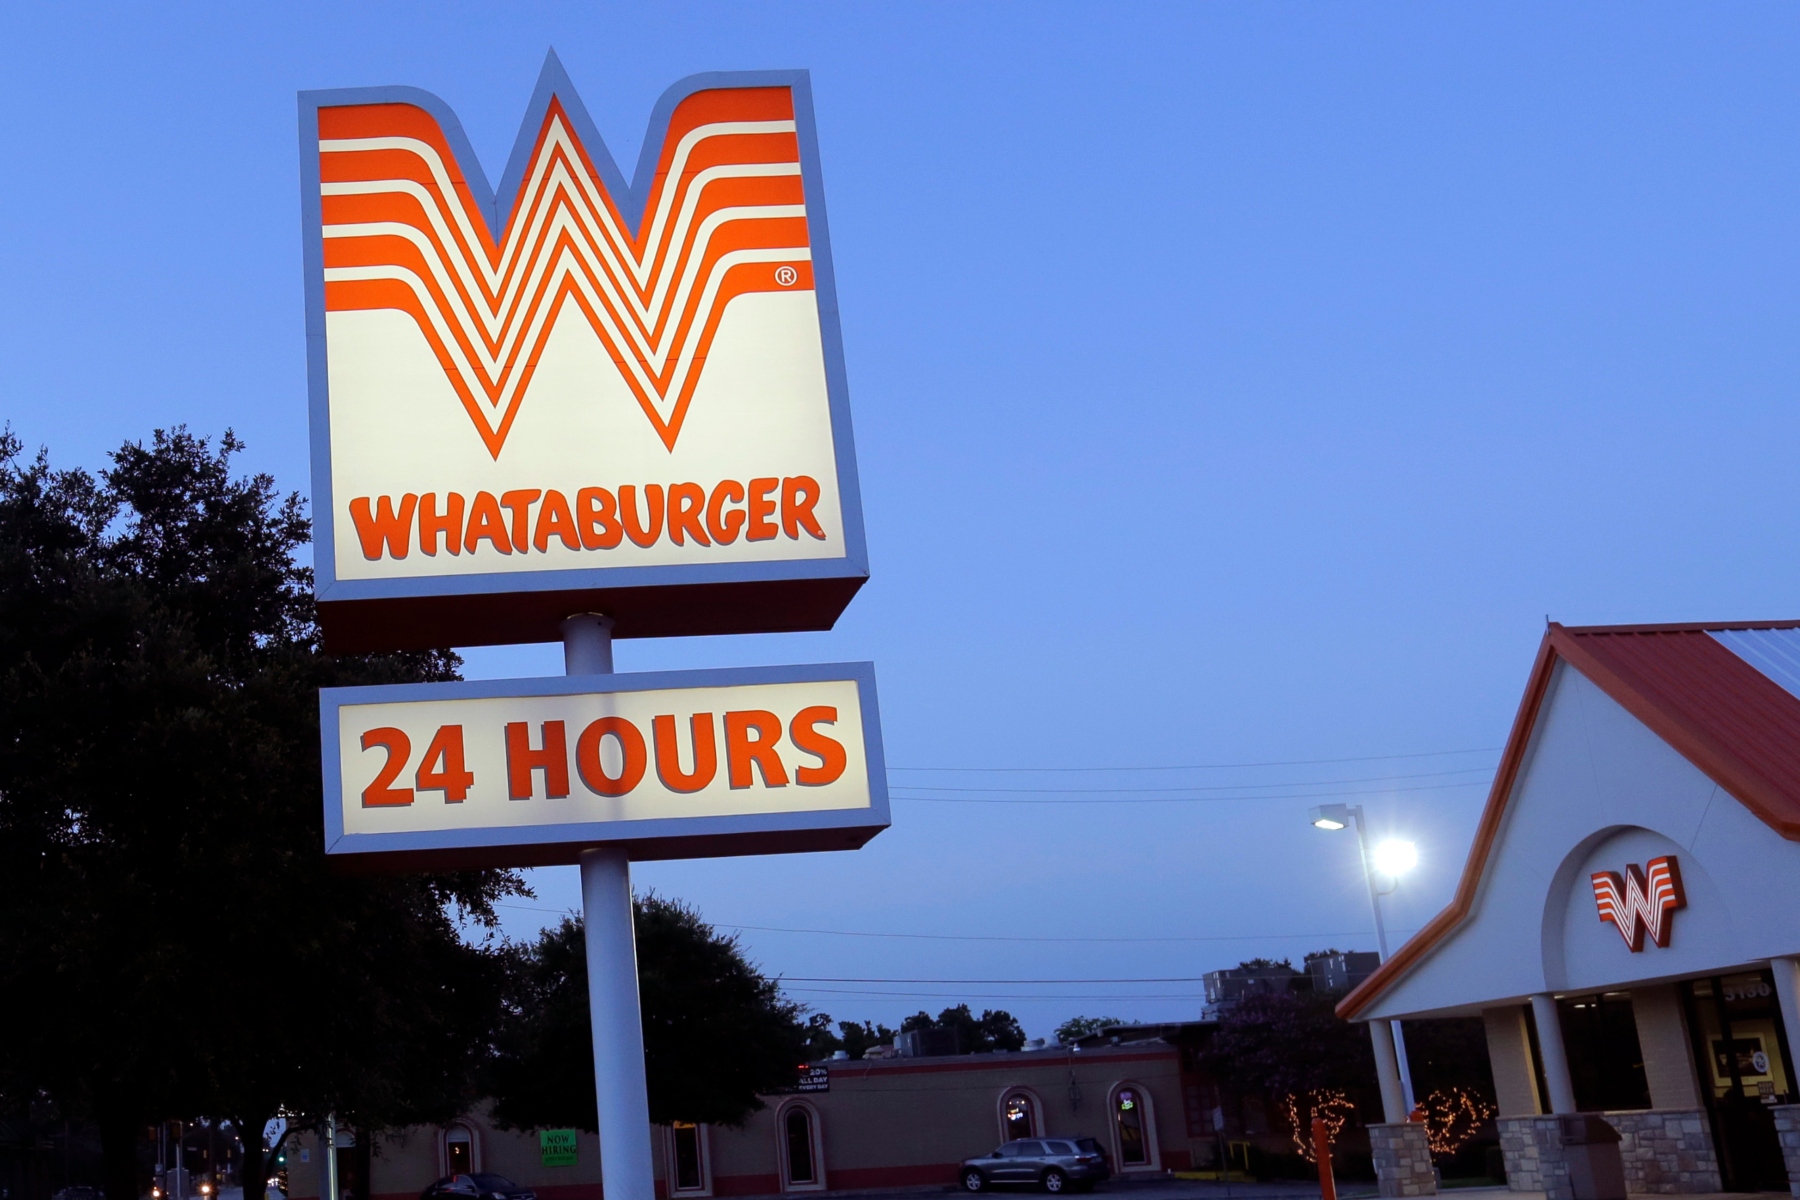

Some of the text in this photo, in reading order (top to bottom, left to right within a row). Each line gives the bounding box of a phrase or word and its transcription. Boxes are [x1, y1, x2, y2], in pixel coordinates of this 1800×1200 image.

[317, 86, 816, 462] W
[349, 475, 826, 561] WHATABURGER
[361, 705, 847, 809] 24 HOURS
[1591, 855, 1687, 953] W
[542, 1145, 576, 1155] HIRING
[547, 1134, 569, 1144] NOW
